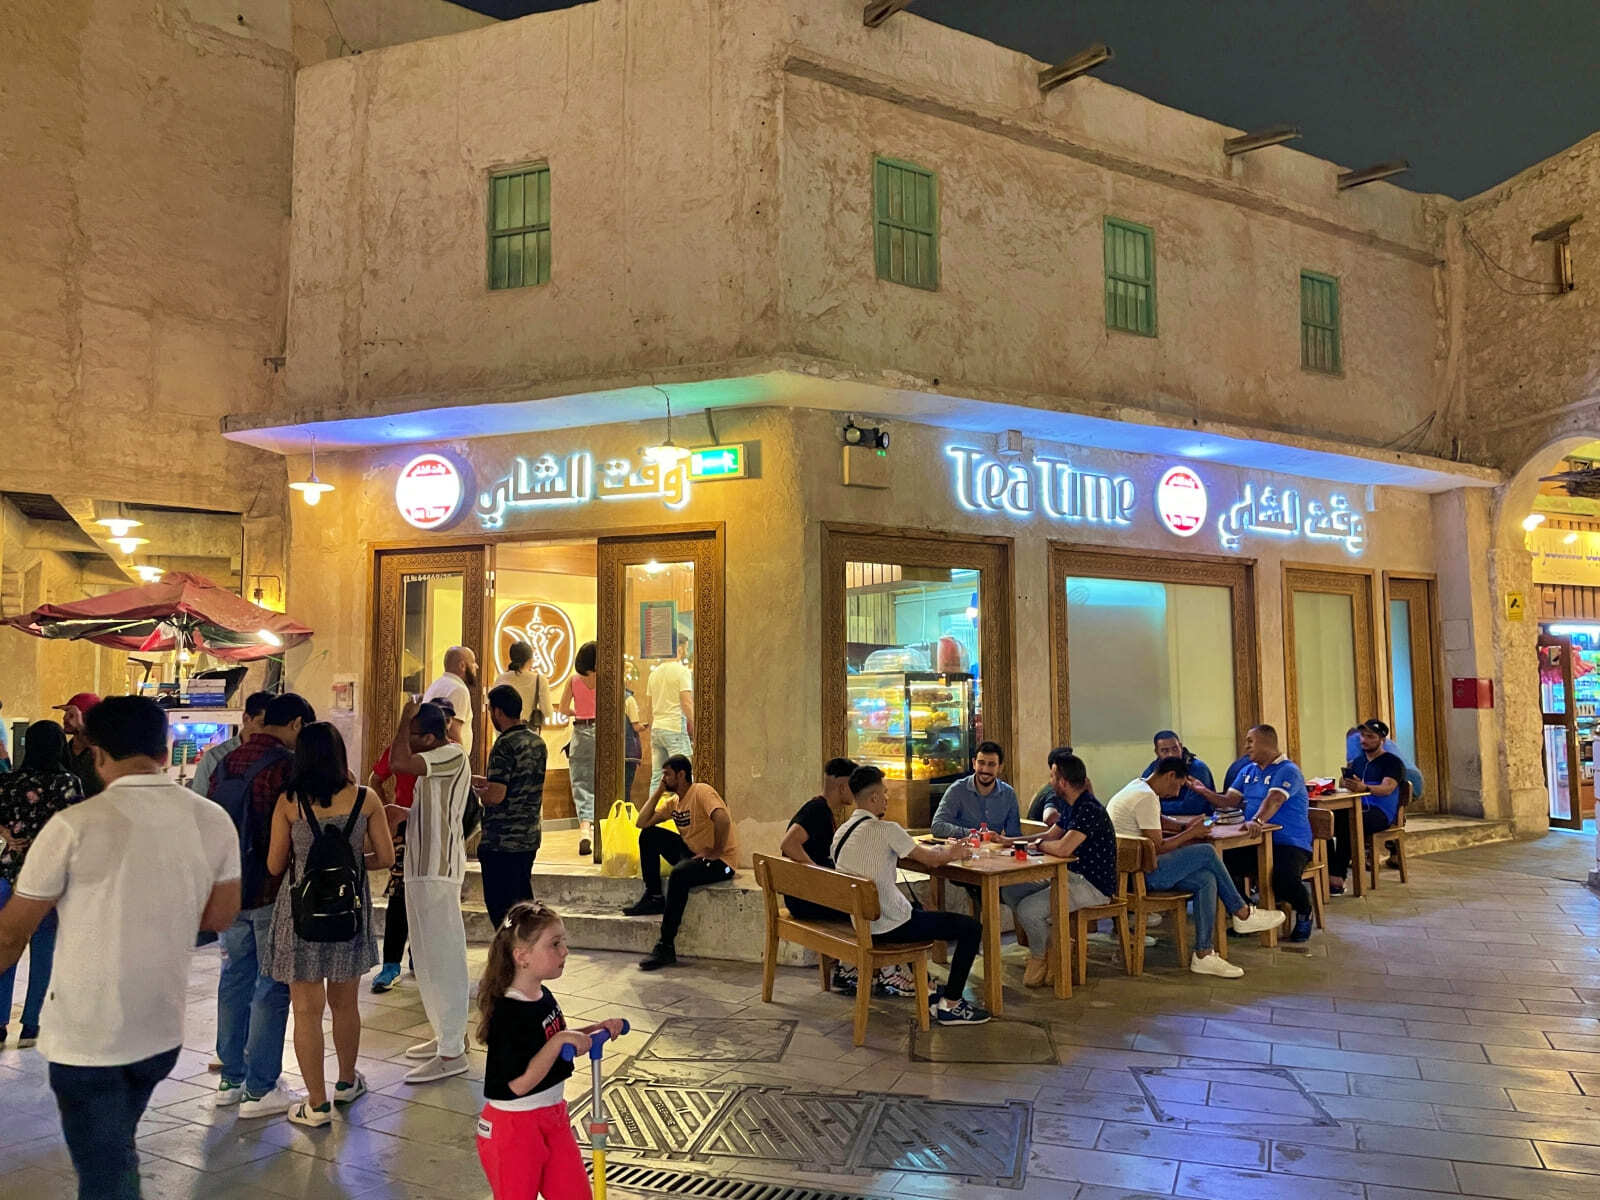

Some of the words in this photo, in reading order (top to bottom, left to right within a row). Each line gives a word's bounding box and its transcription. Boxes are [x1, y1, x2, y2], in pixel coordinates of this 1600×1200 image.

[476, 452, 593, 528] الشاي
[945, 444, 1034, 515] Tea
[1033, 456, 1135, 525] Time
[1218, 482, 1300, 550] الشاي
[1304, 493, 1366, 554] وقت
